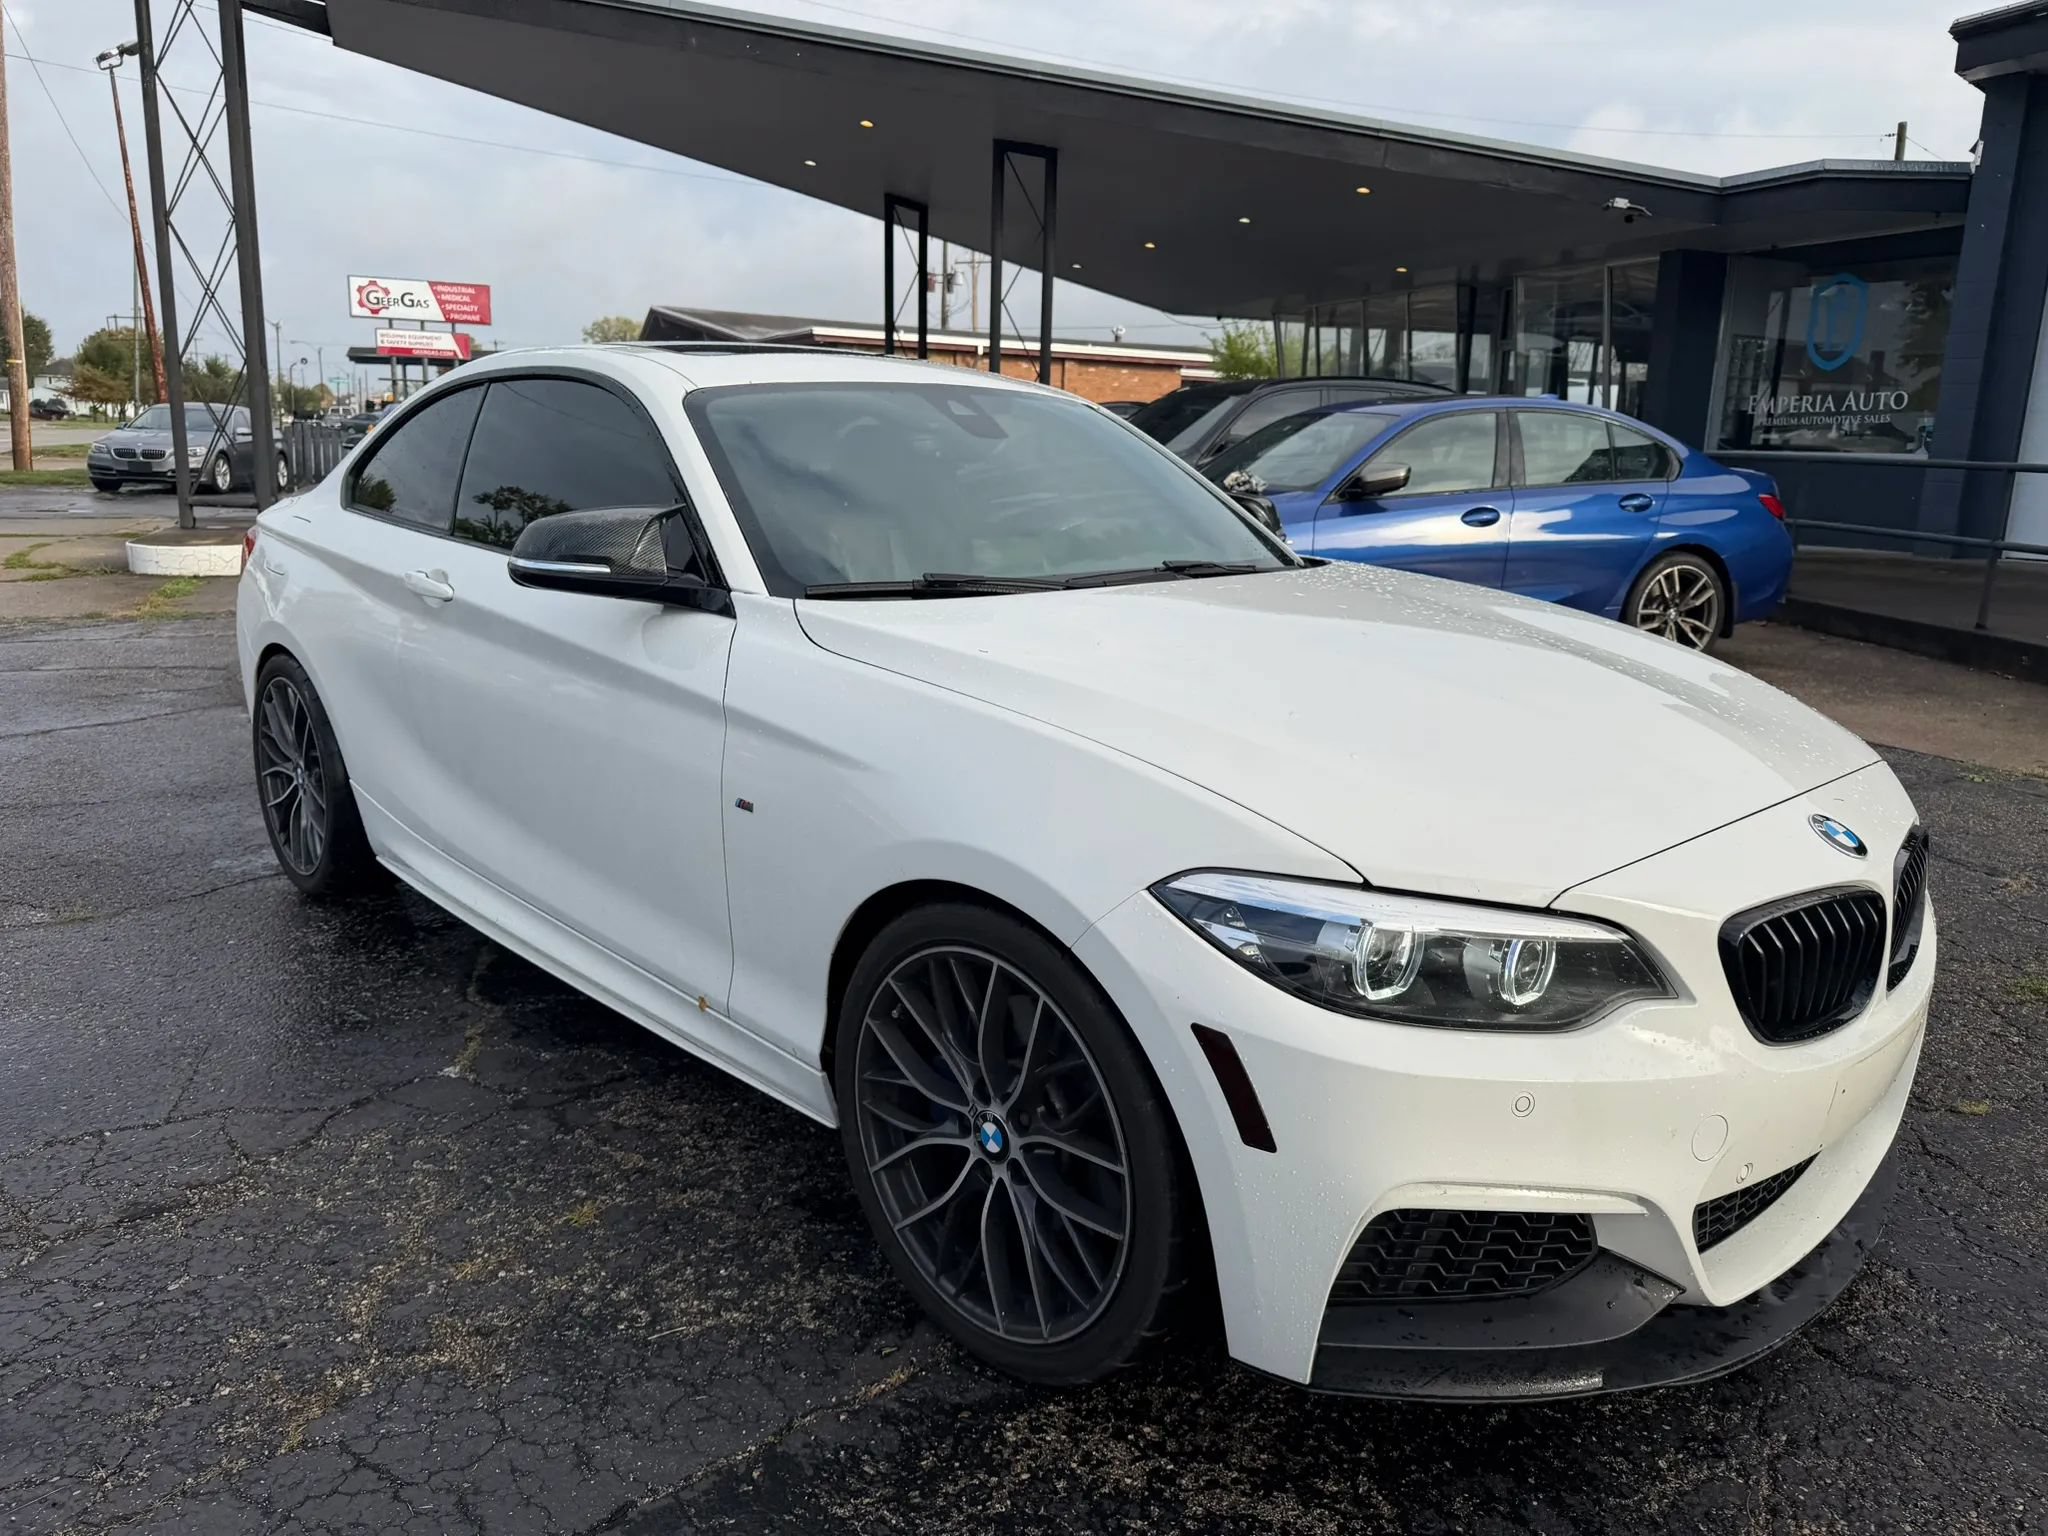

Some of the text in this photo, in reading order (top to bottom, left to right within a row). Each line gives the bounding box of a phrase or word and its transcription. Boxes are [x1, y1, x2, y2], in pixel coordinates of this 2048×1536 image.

[436, 285, 476, 294] INDUSTRIAL
[441, 293, 471, 303] MEDICAL
[445, 303, 479, 312] SPECIALTY
[449, 312, 481, 322] PROPANE
[1747, 390, 1909, 415] EMPERIA AUTO
[1759, 413, 1891, 427] PREMIUM AUTOMOTIVE SALES
